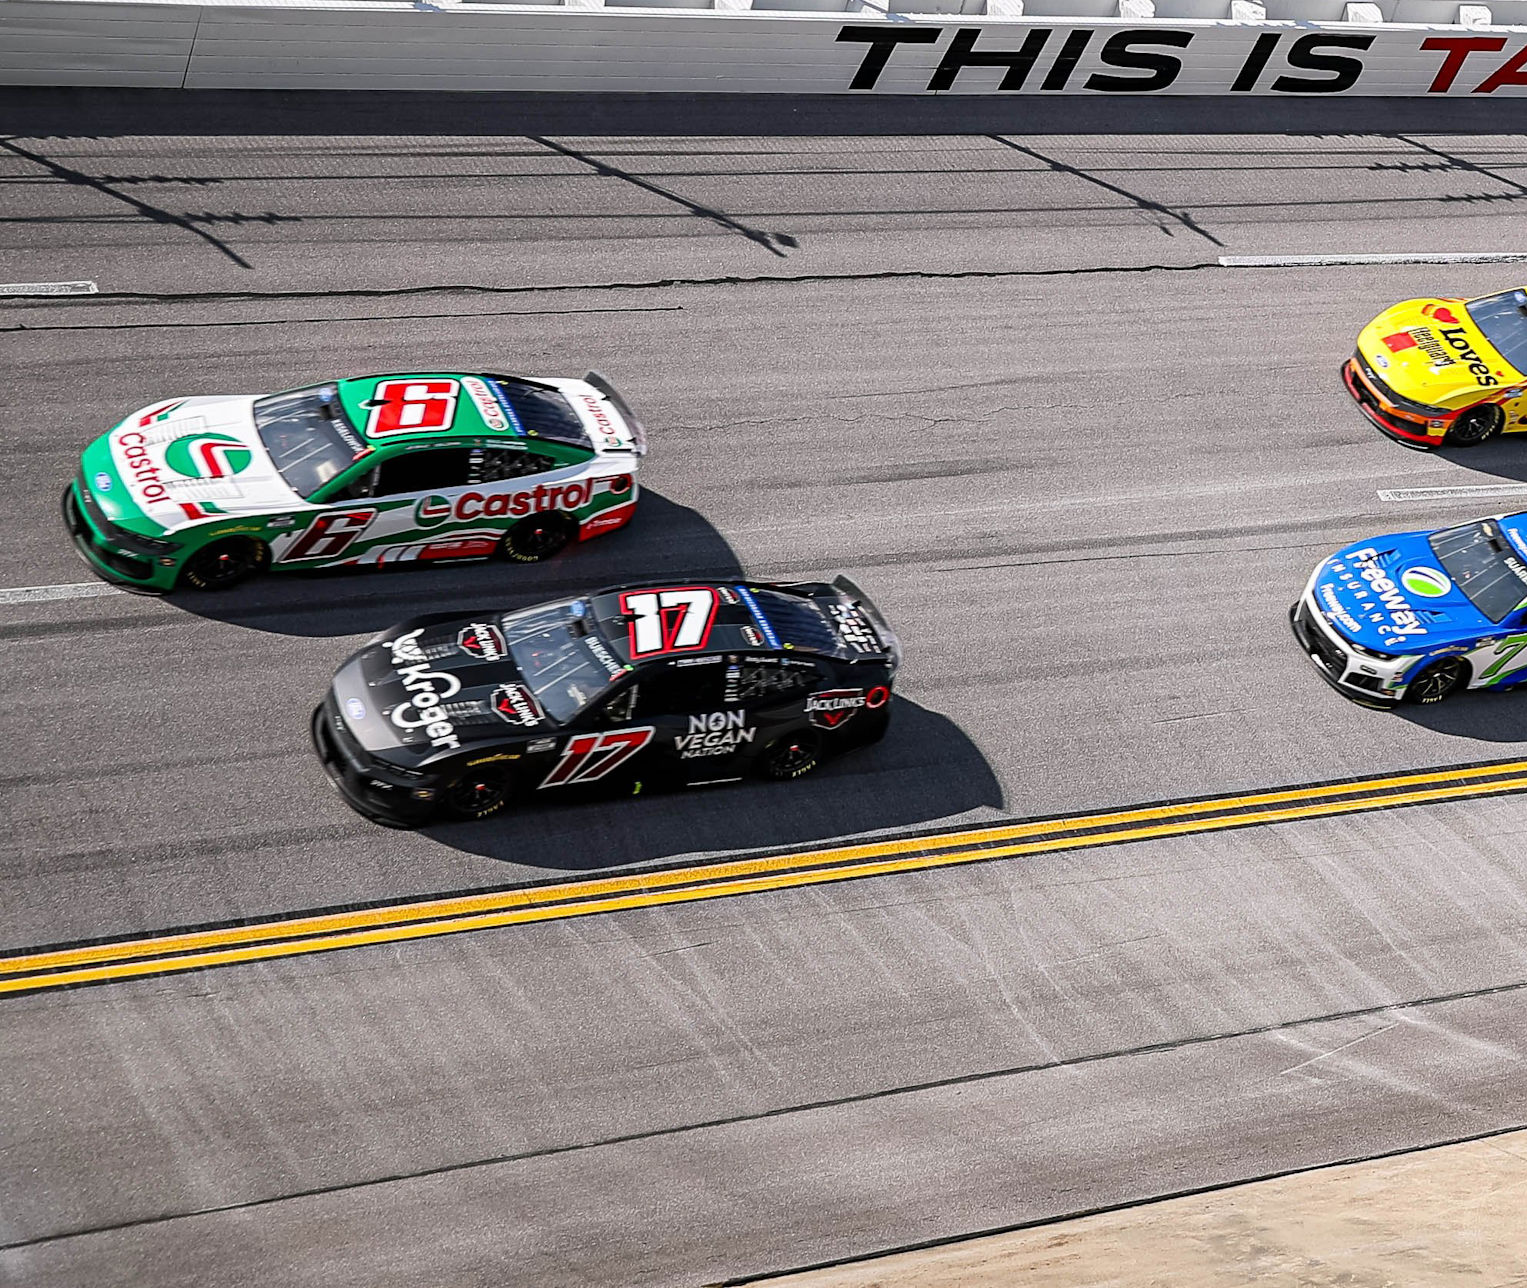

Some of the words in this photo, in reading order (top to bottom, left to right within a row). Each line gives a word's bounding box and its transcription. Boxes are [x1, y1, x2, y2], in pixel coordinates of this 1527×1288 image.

[836, 25, 1195, 92] THIS
[1230, 32, 1377, 93] IS
[368, 379, 457, 437] 6
[466, 377, 501, 420] Castrol
[579, 393, 615, 436] Castrol
[119, 431, 171, 504] Castrol
[455, 478, 594, 520] Castrol
[279, 509, 377, 563] 6
[1320, 582, 1362, 633] Freeway.com
[1327, 559, 1407, 646] INSURANCE
[1346, 547, 1428, 635] Freeway
[470, 623, 489, 642] JACK
[623, 588, 717, 657] 17
[391, 663, 461, 749] Kroger
[499, 683, 519, 704] JACK
[804, 696, 834, 713] JACK
[673, 727, 756, 752] VEGAN
[689, 710, 745, 733] NON
[536, 726, 656, 789] 17
[681, 744, 737, 759] NATION
